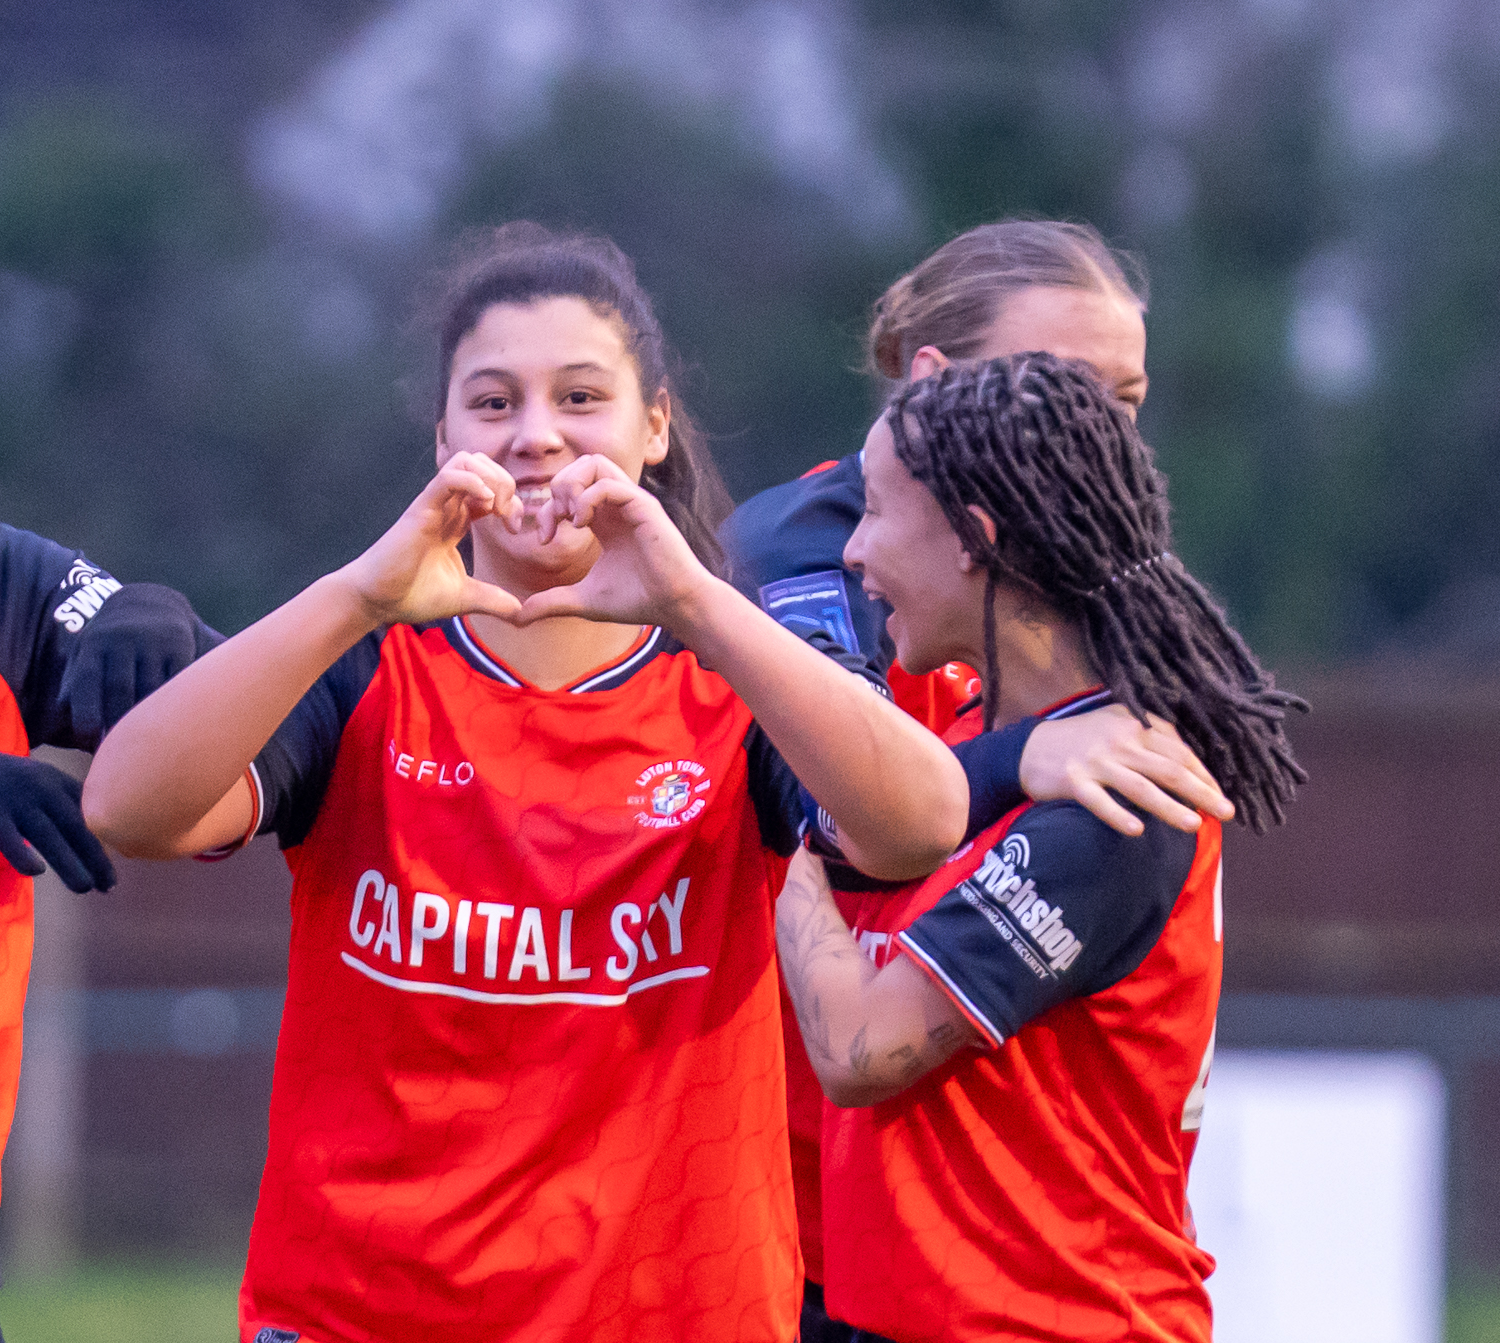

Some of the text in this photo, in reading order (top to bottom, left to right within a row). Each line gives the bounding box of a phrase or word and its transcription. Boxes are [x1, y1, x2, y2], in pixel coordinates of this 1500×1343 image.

[635, 761, 673, 787] LUTON
[677, 760, 706, 778] TOWN
[349, 868, 591, 982] CAPITAL
